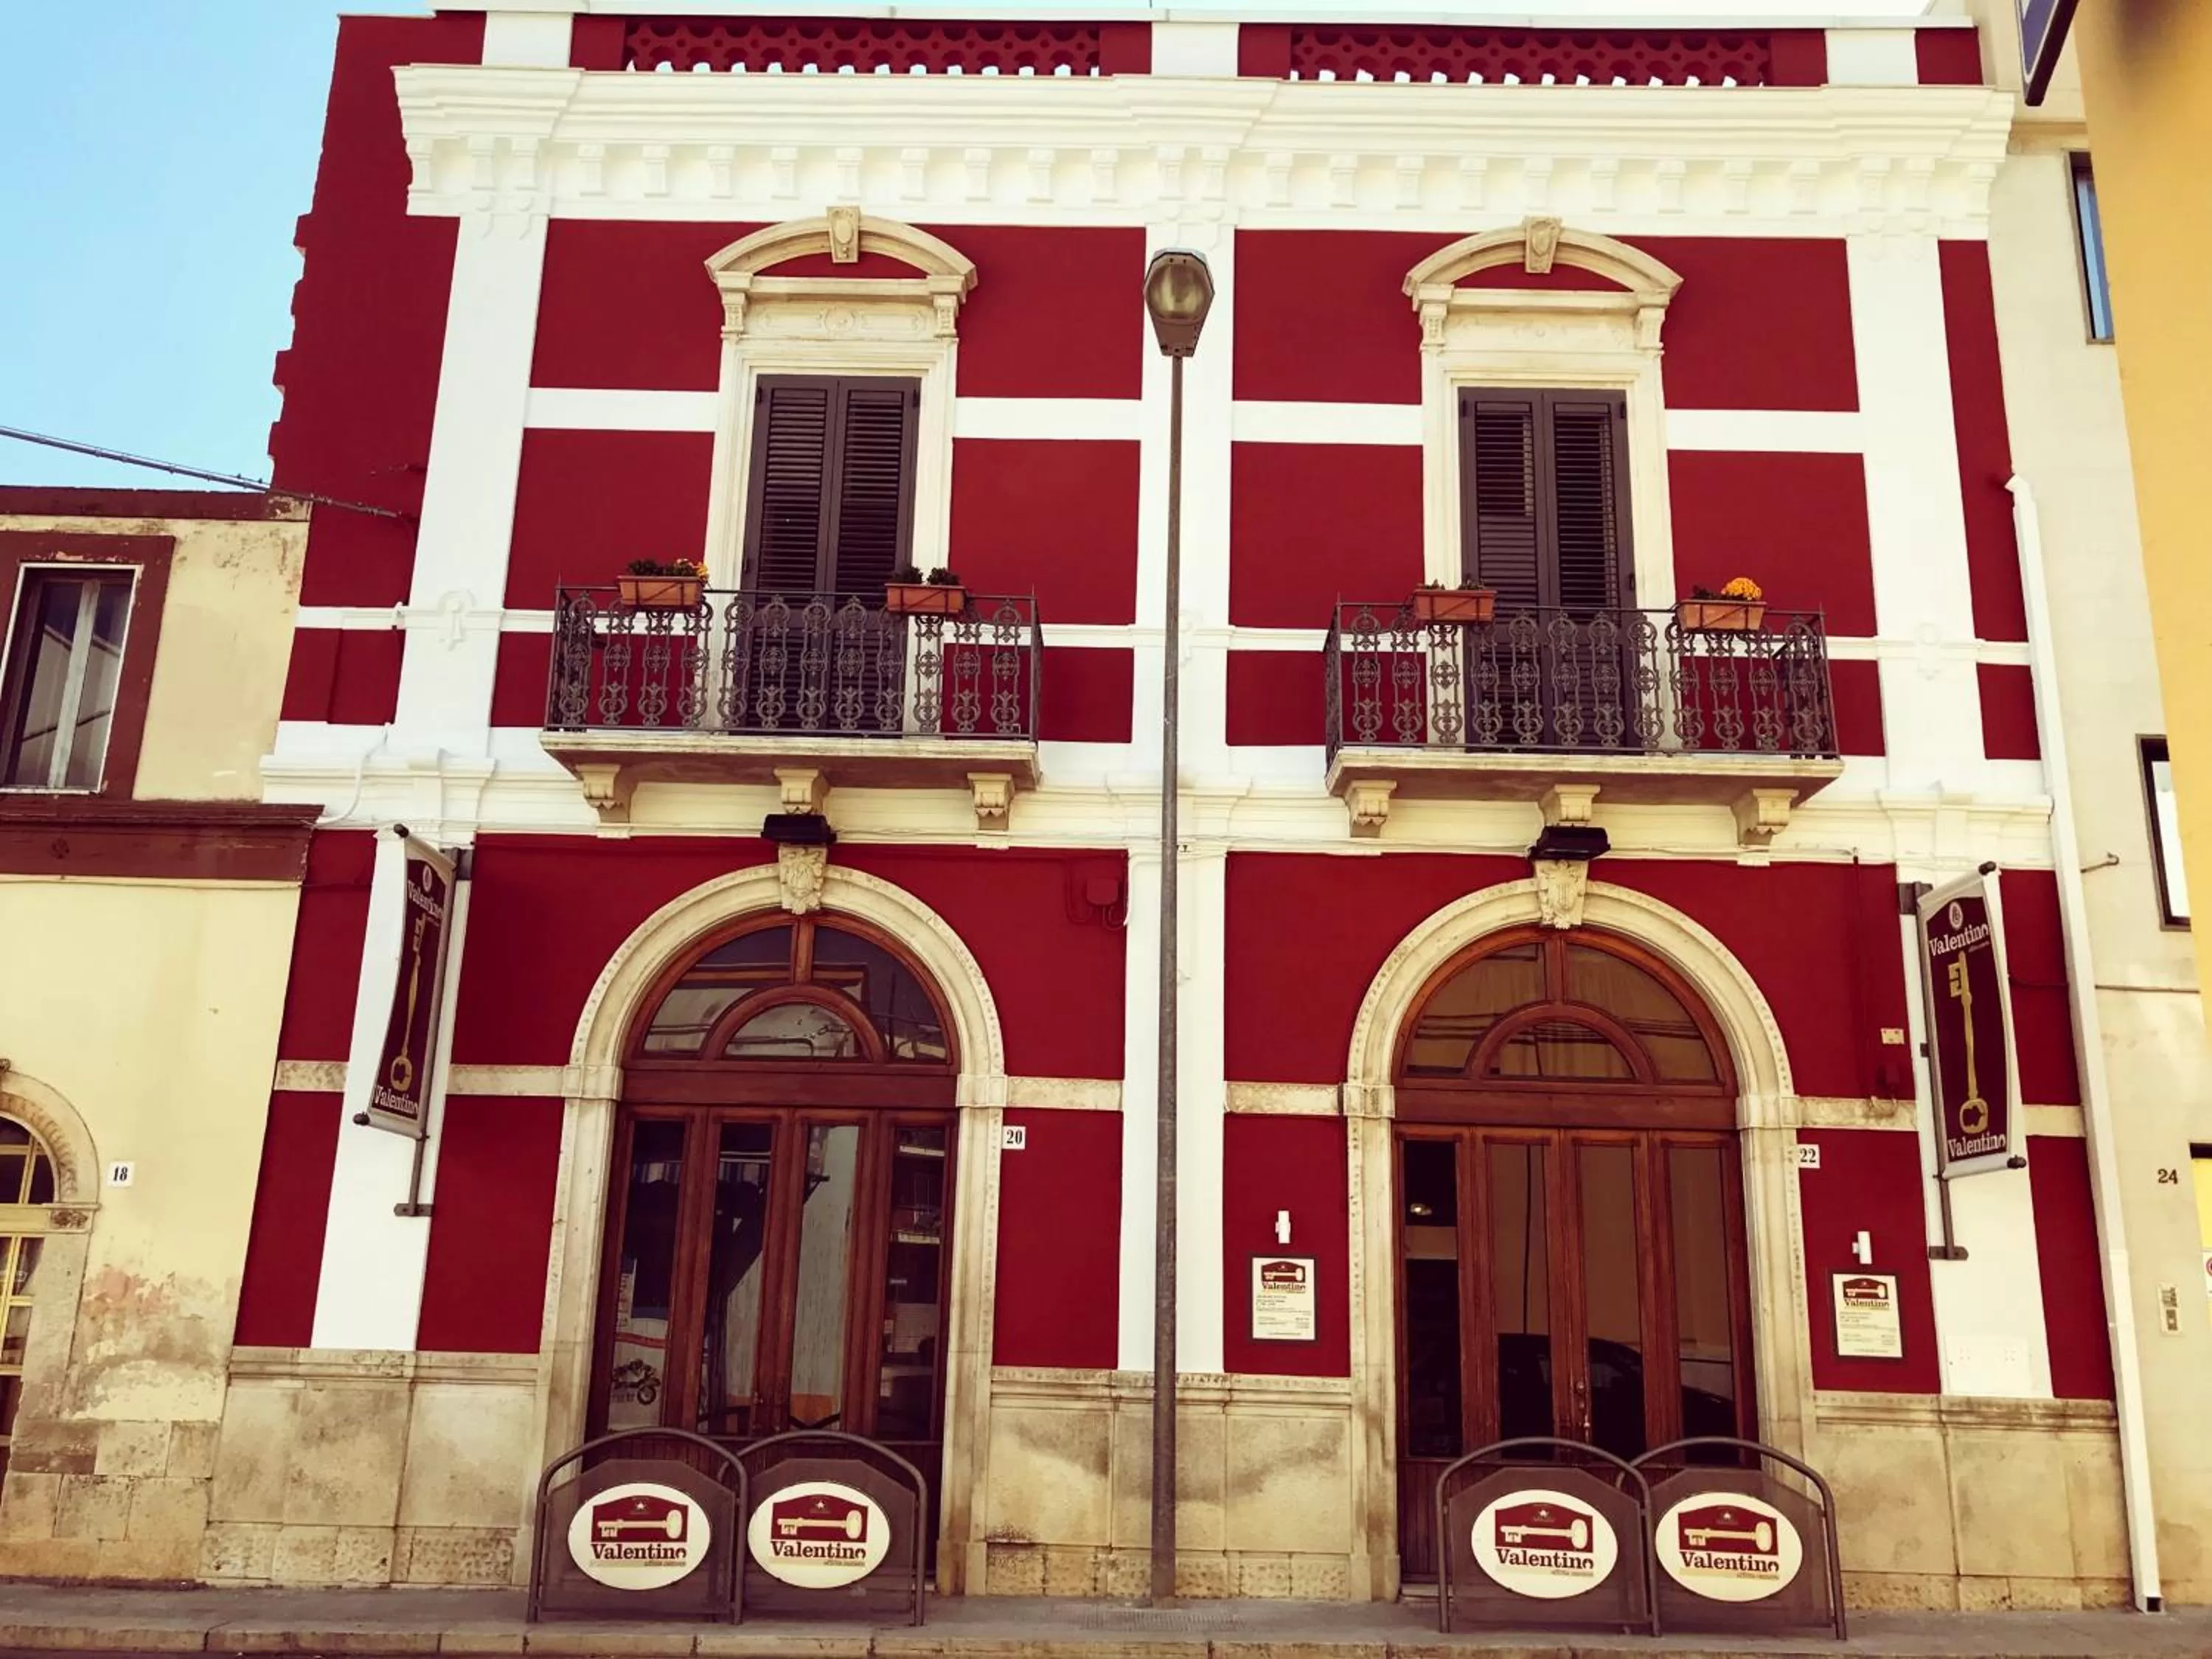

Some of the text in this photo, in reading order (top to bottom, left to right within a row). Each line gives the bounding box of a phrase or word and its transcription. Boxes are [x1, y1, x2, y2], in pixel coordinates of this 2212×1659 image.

[1929, 923, 1989, 956] Valentino
[374, 1085, 419, 1114] Valentino
[1006, 1129, 1023, 1144] 20
[1948, 1131, 2006, 1158] Valentino
[1799, 1148, 1816, 1163] 22
[113, 1166, 128, 1181] 18
[2157, 1168, 2178, 1184] 24
[591, 1543, 686, 1559] Valentino
[771, 1540, 866, 1559] Valentino
[1495, 1548, 1594, 1569] Valentino
[1680, 1551, 1780, 1573] Valentino
